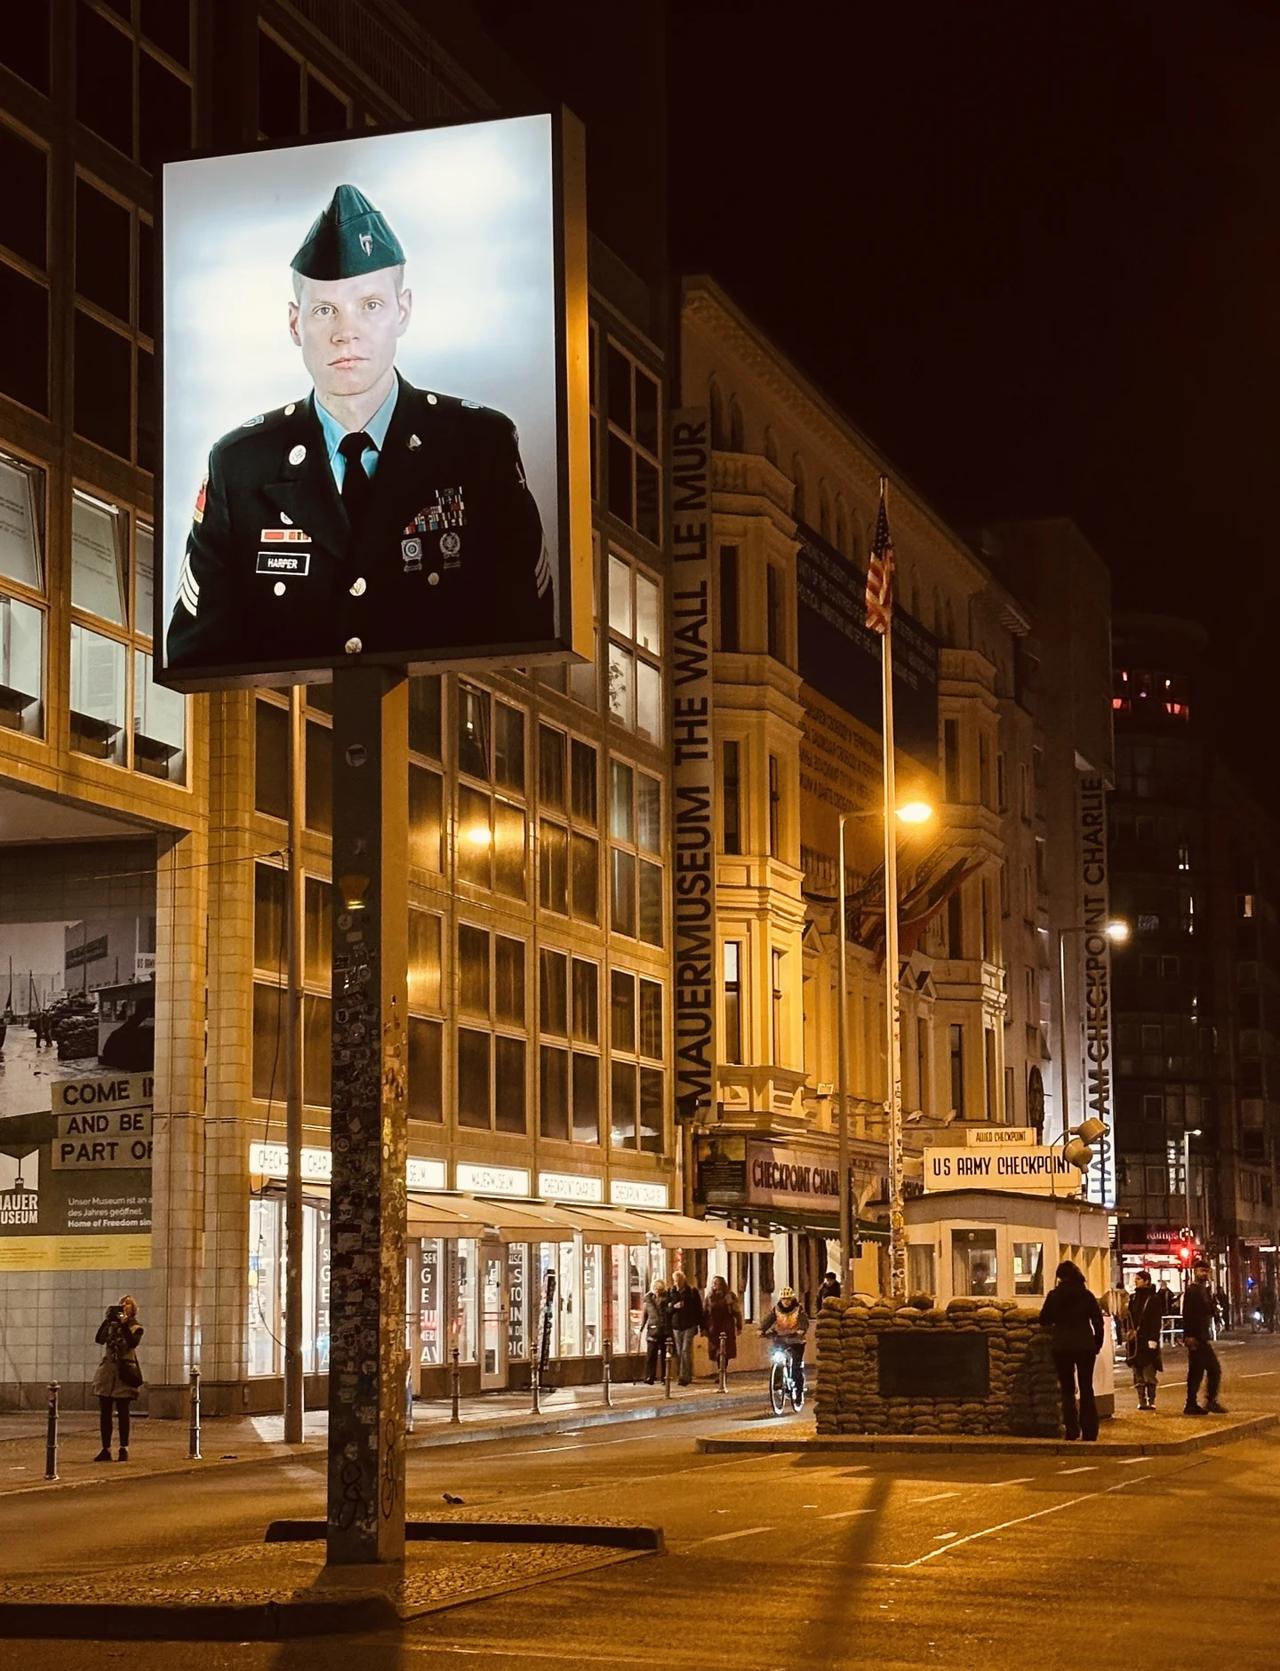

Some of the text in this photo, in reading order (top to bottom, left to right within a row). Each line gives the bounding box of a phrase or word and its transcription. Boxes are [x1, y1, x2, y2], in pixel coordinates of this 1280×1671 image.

[267, 558, 298, 569] HARPER
[673, 422, 712, 1116] MAUERMUSEUM THE WALL LE MUR
[1082, 776, 1105, 885] CHARLIE
[1084, 895, 1109, 1064] CHECKPOINT
[63, 1080, 130, 1106] COME
[66, 1113, 145, 1134] AND BE
[994, 1130, 1027, 1143] CHECKPOINT
[60, 1142, 119, 1162] PART
[752, 1158, 811, 1194] CHECKPOINT
[957, 1156, 991, 1176] ARMY
[68, 1197, 91, 1206] Unser
[92, 1197, 125, 1205] Museum
[67, 1208, 82, 1217] des
[84, 1208, 108, 1216] Jahres
[67, 1219, 92, 1228] Home
[93, 1218, 101, 1227] of
[102, 1218, 139, 1227] Freedom
